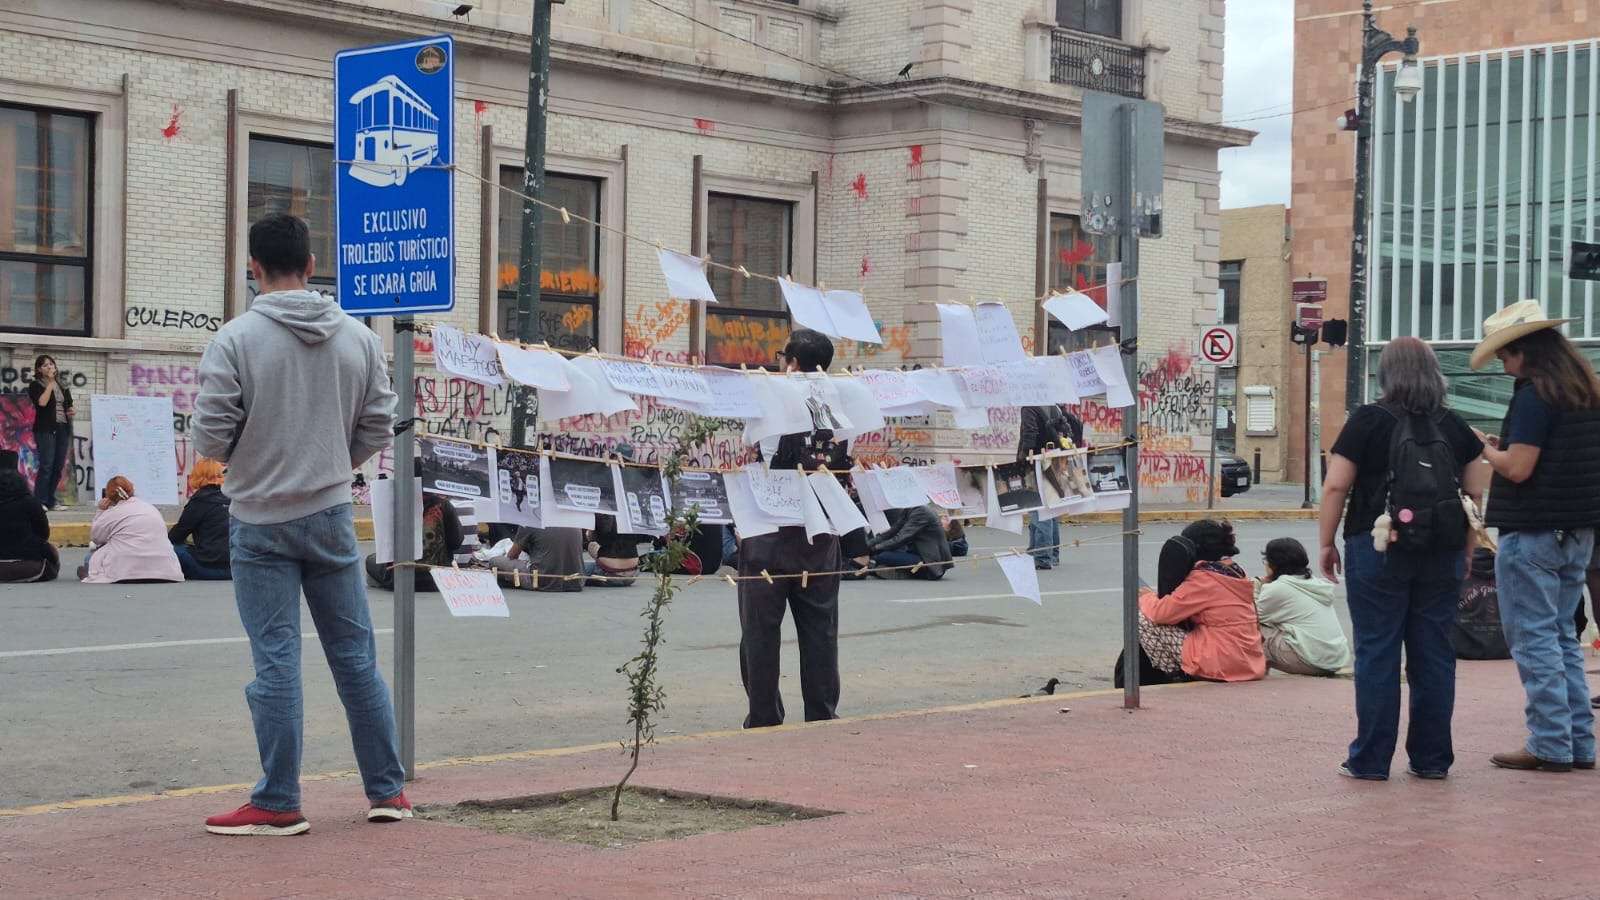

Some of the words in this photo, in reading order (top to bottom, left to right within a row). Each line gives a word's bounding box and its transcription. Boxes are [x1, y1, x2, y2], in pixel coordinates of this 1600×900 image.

[363, 208, 427, 234] EXCLUSIVO
[342, 236, 395, 265] TROLEBÚS
[398, 233, 448, 262] TURÍSTICO
[354, 275, 367, 296] SE
[371, 266, 407, 295] USARÁ
[410, 264, 437, 293] GRÚA
[125, 306, 222, 331] CULEROS
